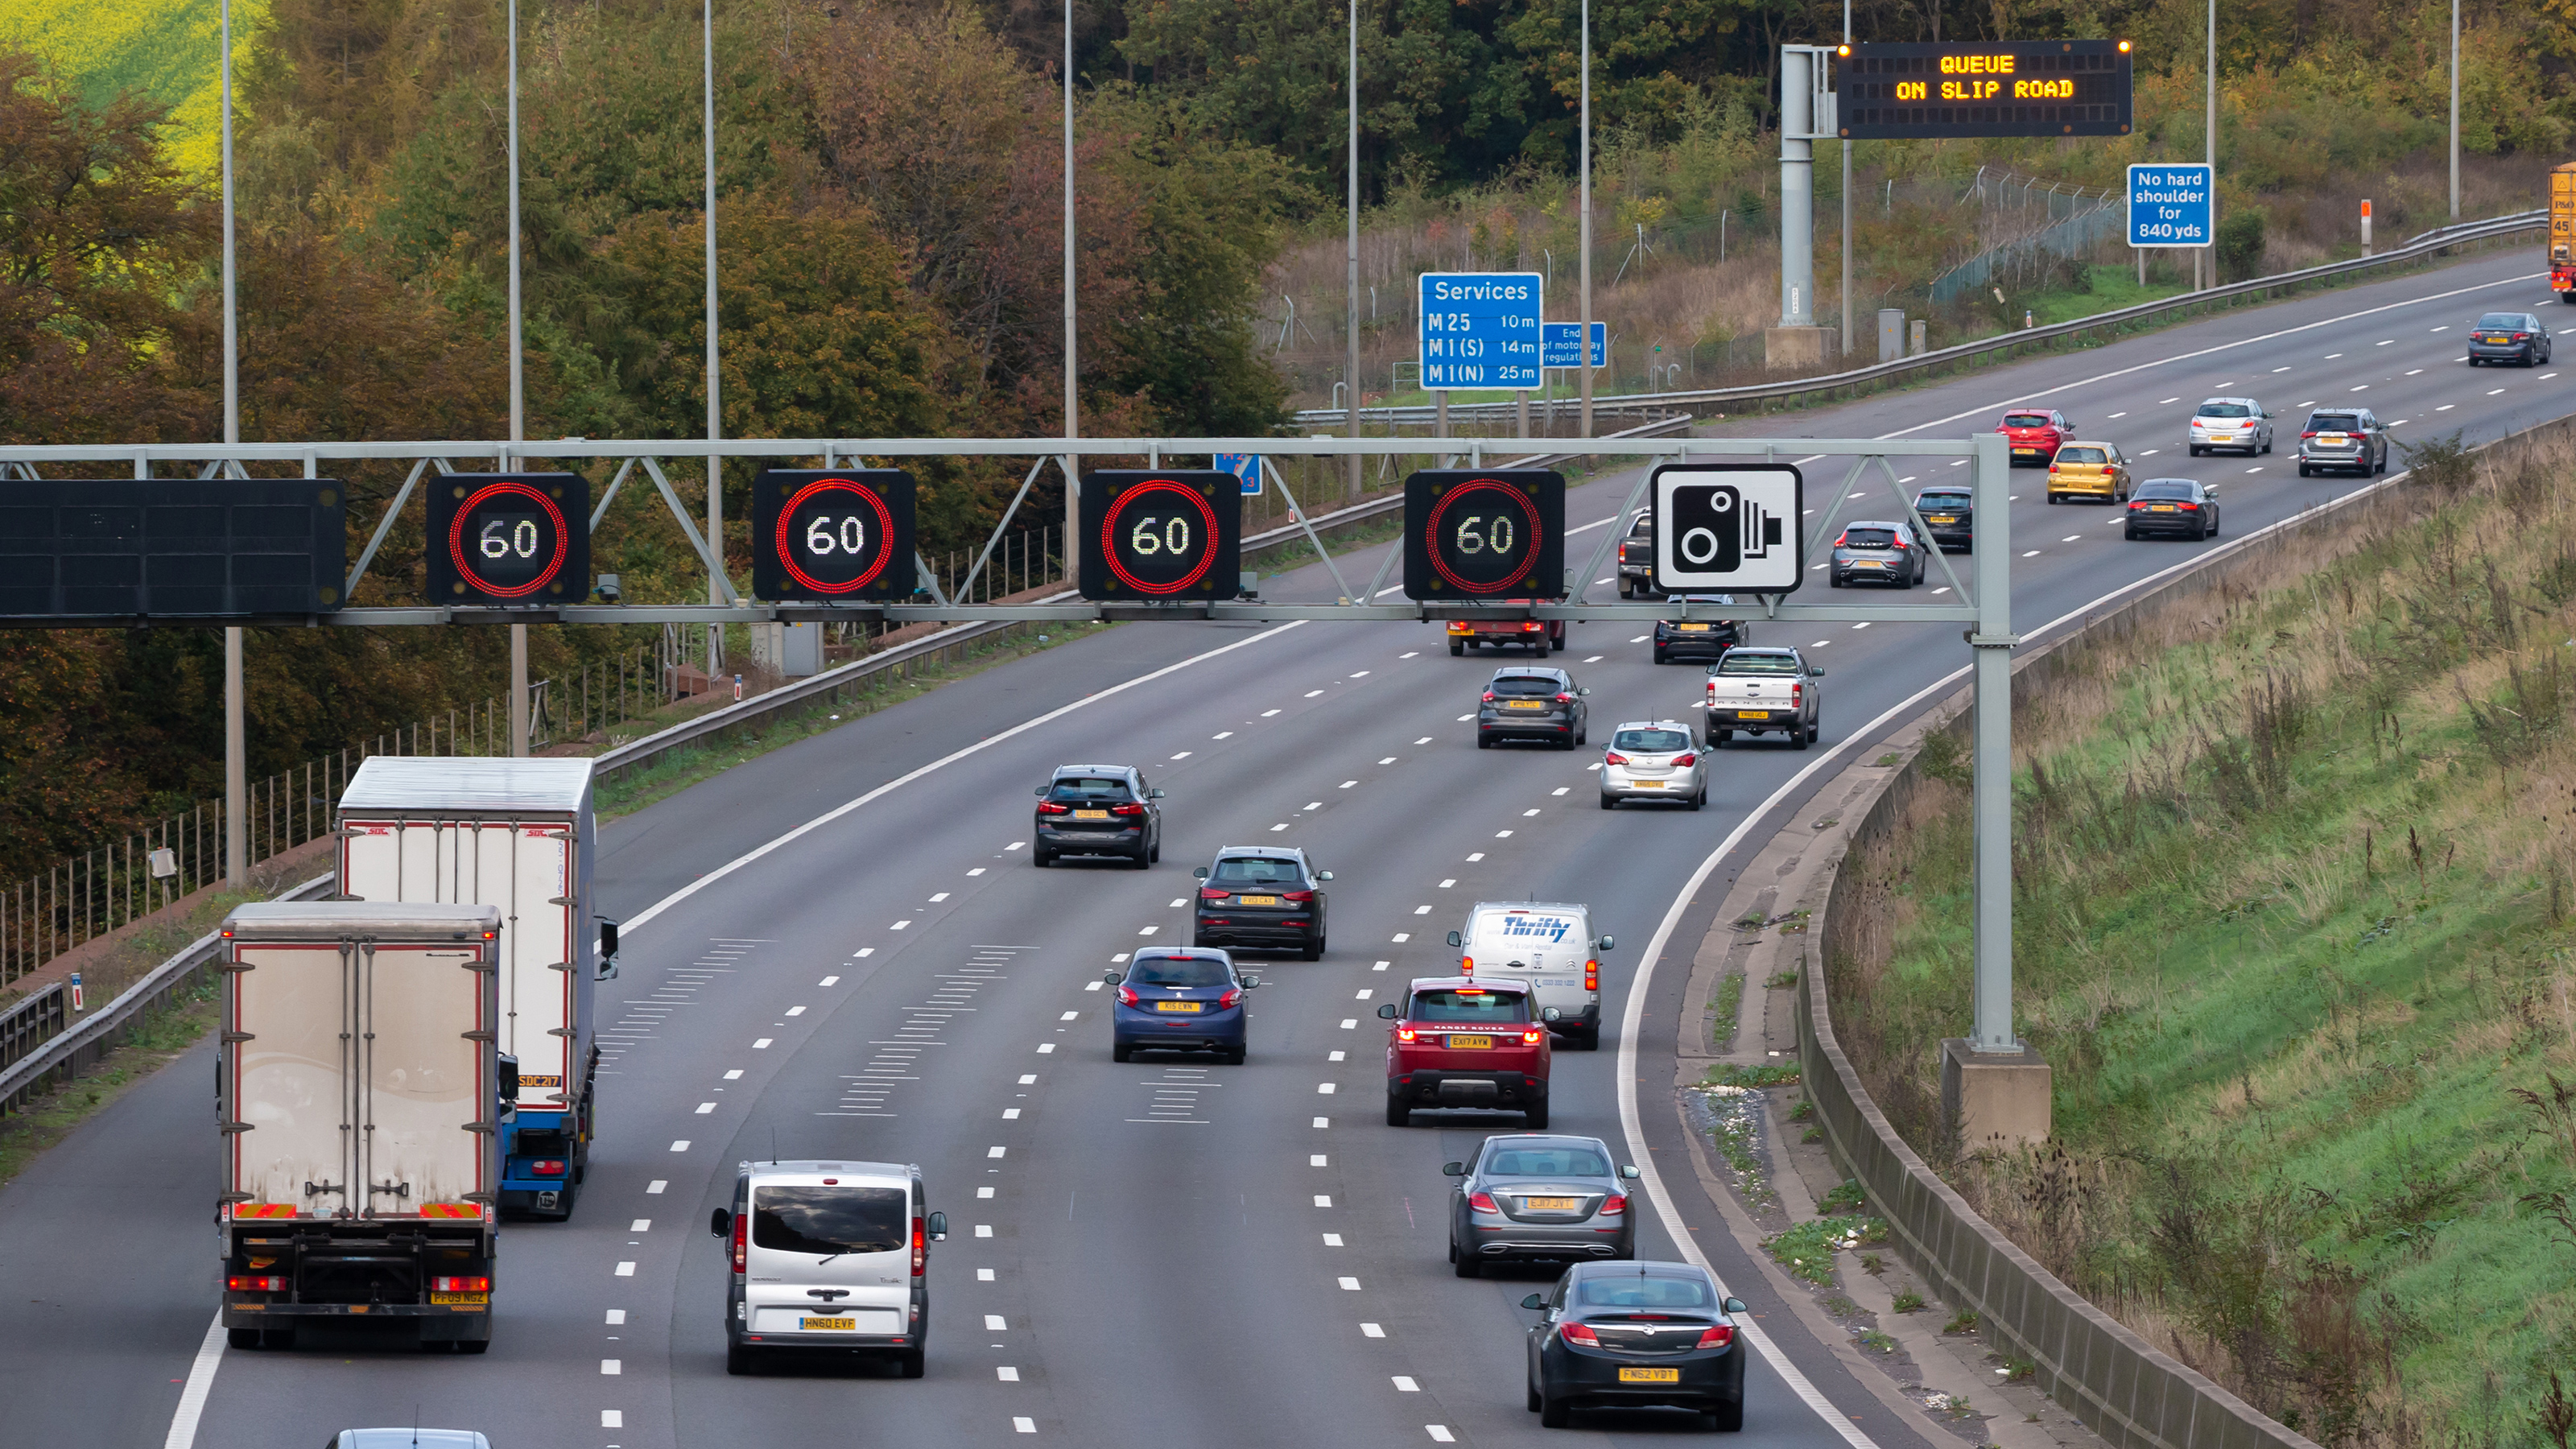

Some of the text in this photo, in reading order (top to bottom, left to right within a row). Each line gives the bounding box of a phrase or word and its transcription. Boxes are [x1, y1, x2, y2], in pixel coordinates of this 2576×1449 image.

[1940, 56, 2014, 73] QUEUE
[1897, 80, 2074, 100] ON SLIP ROAD
[2138, 171, 2202, 186] No hard
[2135, 189, 2204, 203] shoulder
[2158, 206, 2182, 219] for
[2139, 223, 2202, 240] 840 yds
[2554, 221, 2569, 232] 45
[1435, 282, 1528, 300] Services
[1563, 328, 1582, 337] End
[1542, 341, 1601, 351] of motoay
[1545, 352, 1598, 363] regulatis
[481, 520, 537, 558] 60
[807, 516, 865, 555] 60
[1132, 517, 1190, 555] 60
[1456, 516, 1513, 555] 60
[1503, 917, 1571, 943] Thrifty
[518, 1075, 559, 1086] SDC217
[1530, 1199, 1571, 1207] EJ17 JVT
[435, 1293, 483, 1302] PF09 NGZ
[805, 1319, 854, 1328] HN60 EVF
[1624, 1370, 1650, 1379] FN62
